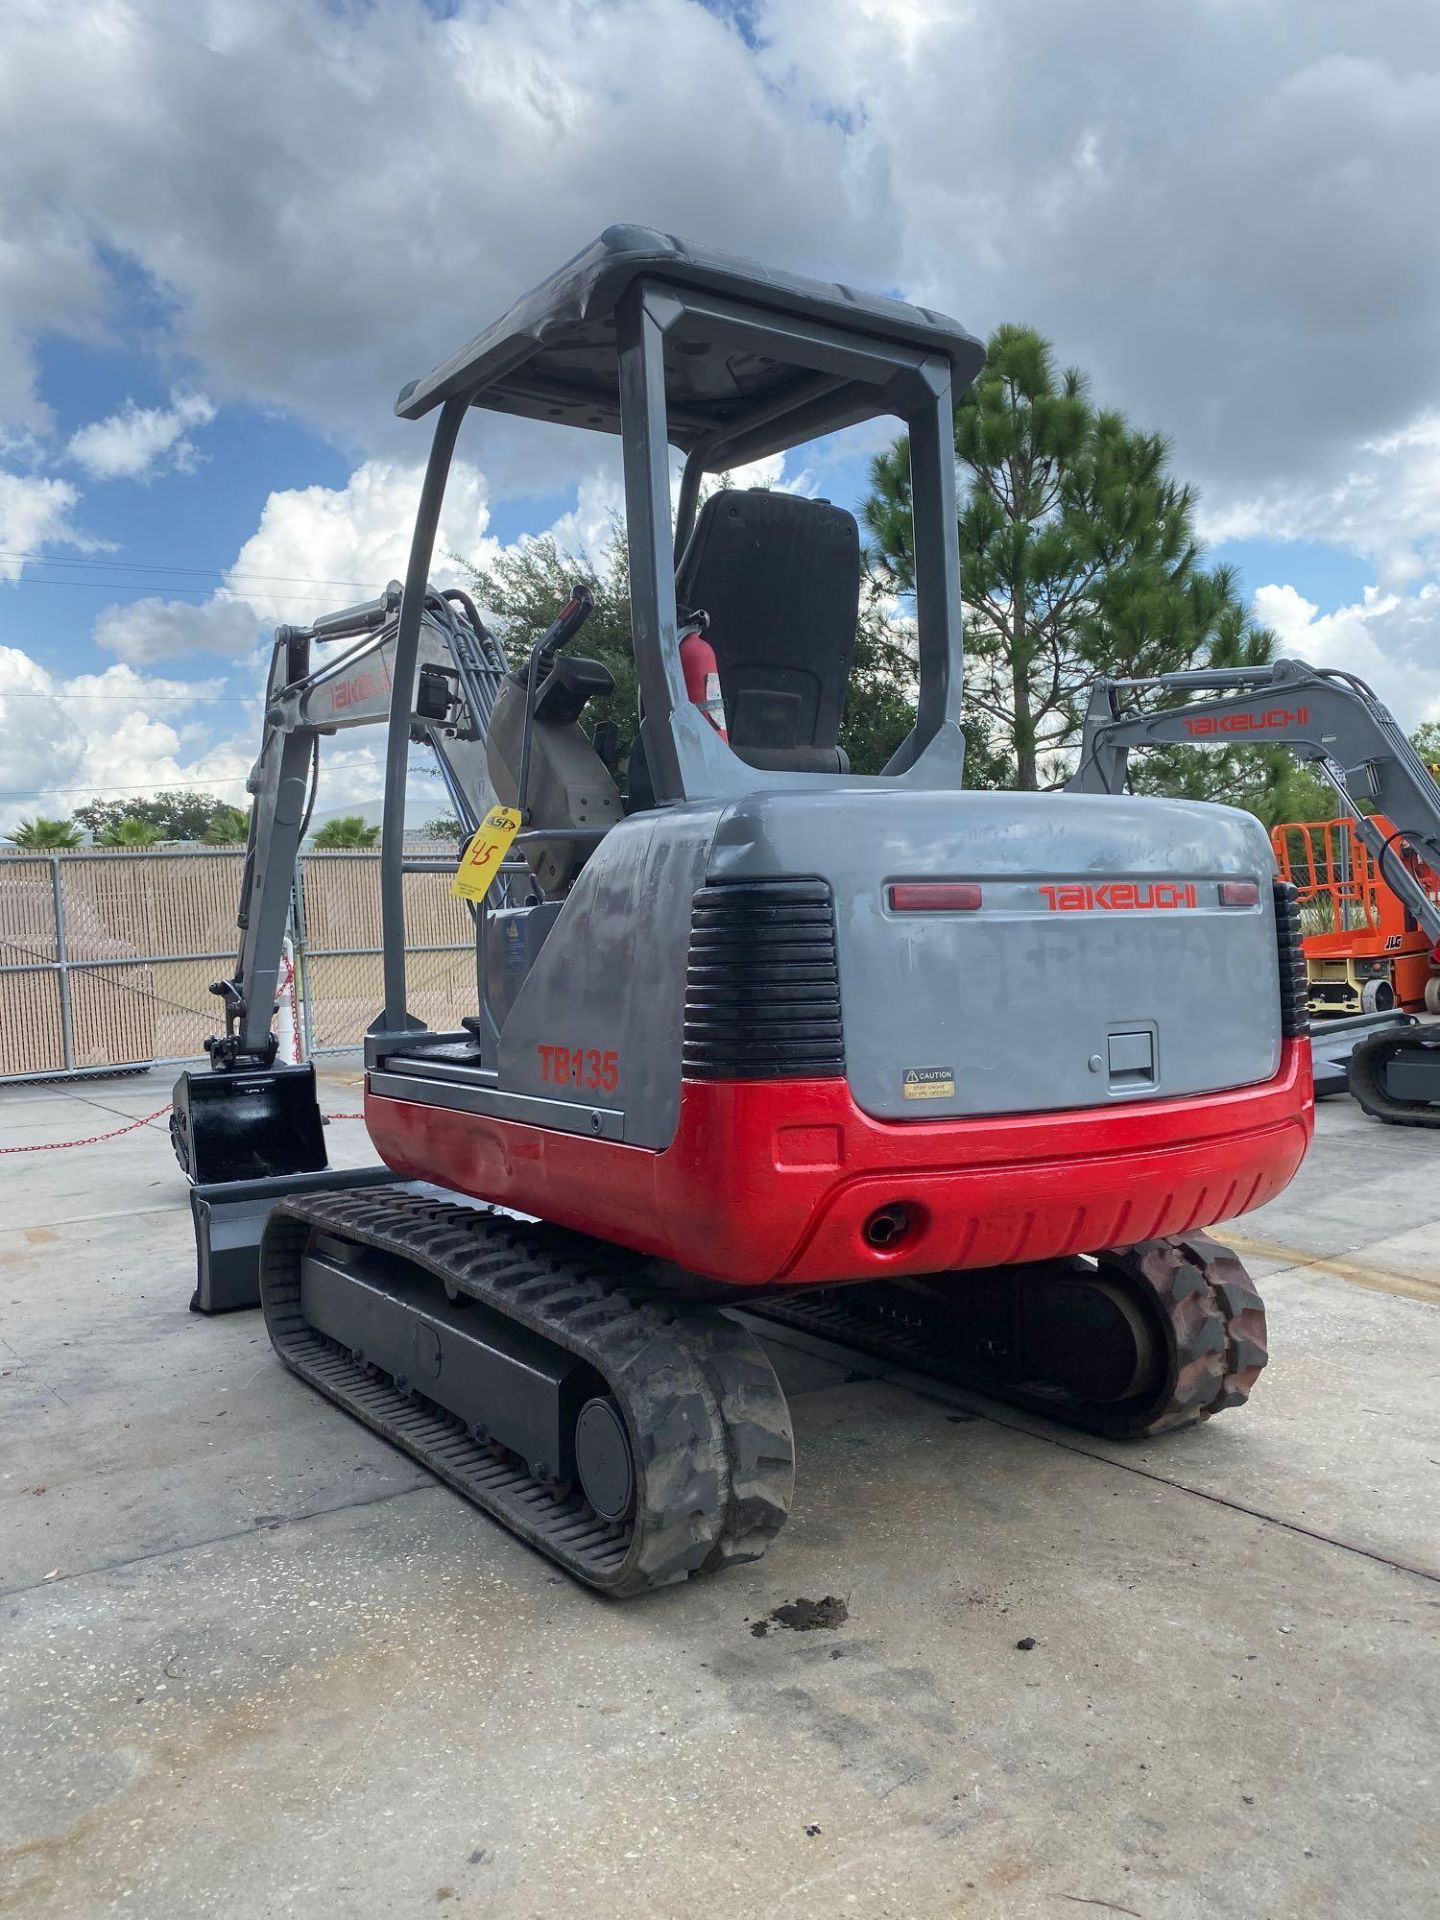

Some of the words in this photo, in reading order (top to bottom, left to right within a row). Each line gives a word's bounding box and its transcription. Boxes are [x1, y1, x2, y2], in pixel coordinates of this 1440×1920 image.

[1183, 706, 1310, 737] TAKEUCHI
[470, 839, 499, 866] 45
[1038, 882, 1197, 912] TAKEUCHI
[1384, 935, 1402, 950] JLG
[537, 1043, 619, 1091] TB135
[919, 1070, 952, 1080] CAUTION
